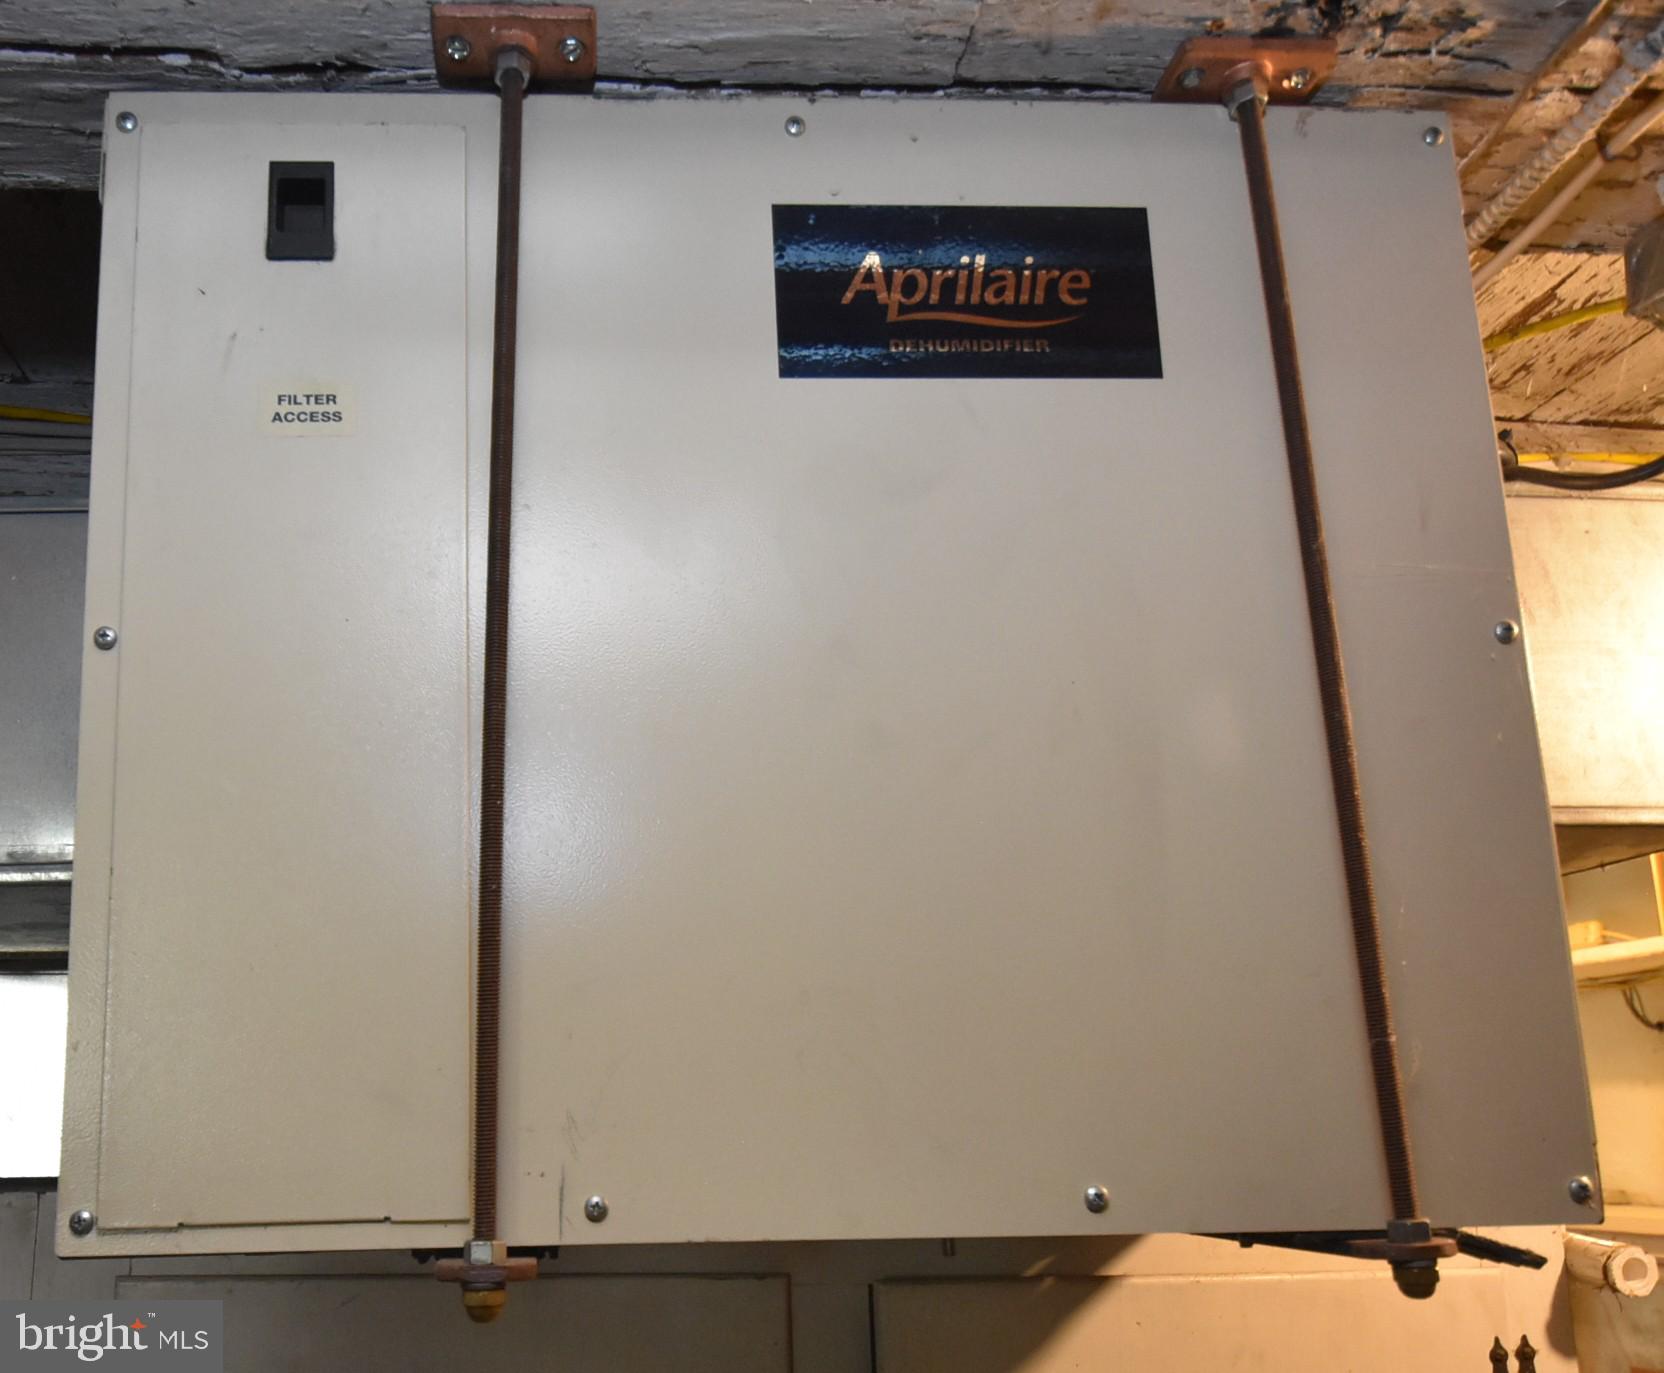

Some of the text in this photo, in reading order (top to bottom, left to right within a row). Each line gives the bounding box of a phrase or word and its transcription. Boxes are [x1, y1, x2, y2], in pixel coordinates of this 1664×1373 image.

[840, 251, 1093, 324] Aprilaire
[888, 338, 1051, 354] DEHUMIDIFIER
[277, 394, 337, 406] FILTER
[271, 411, 343, 423] ACCESS
